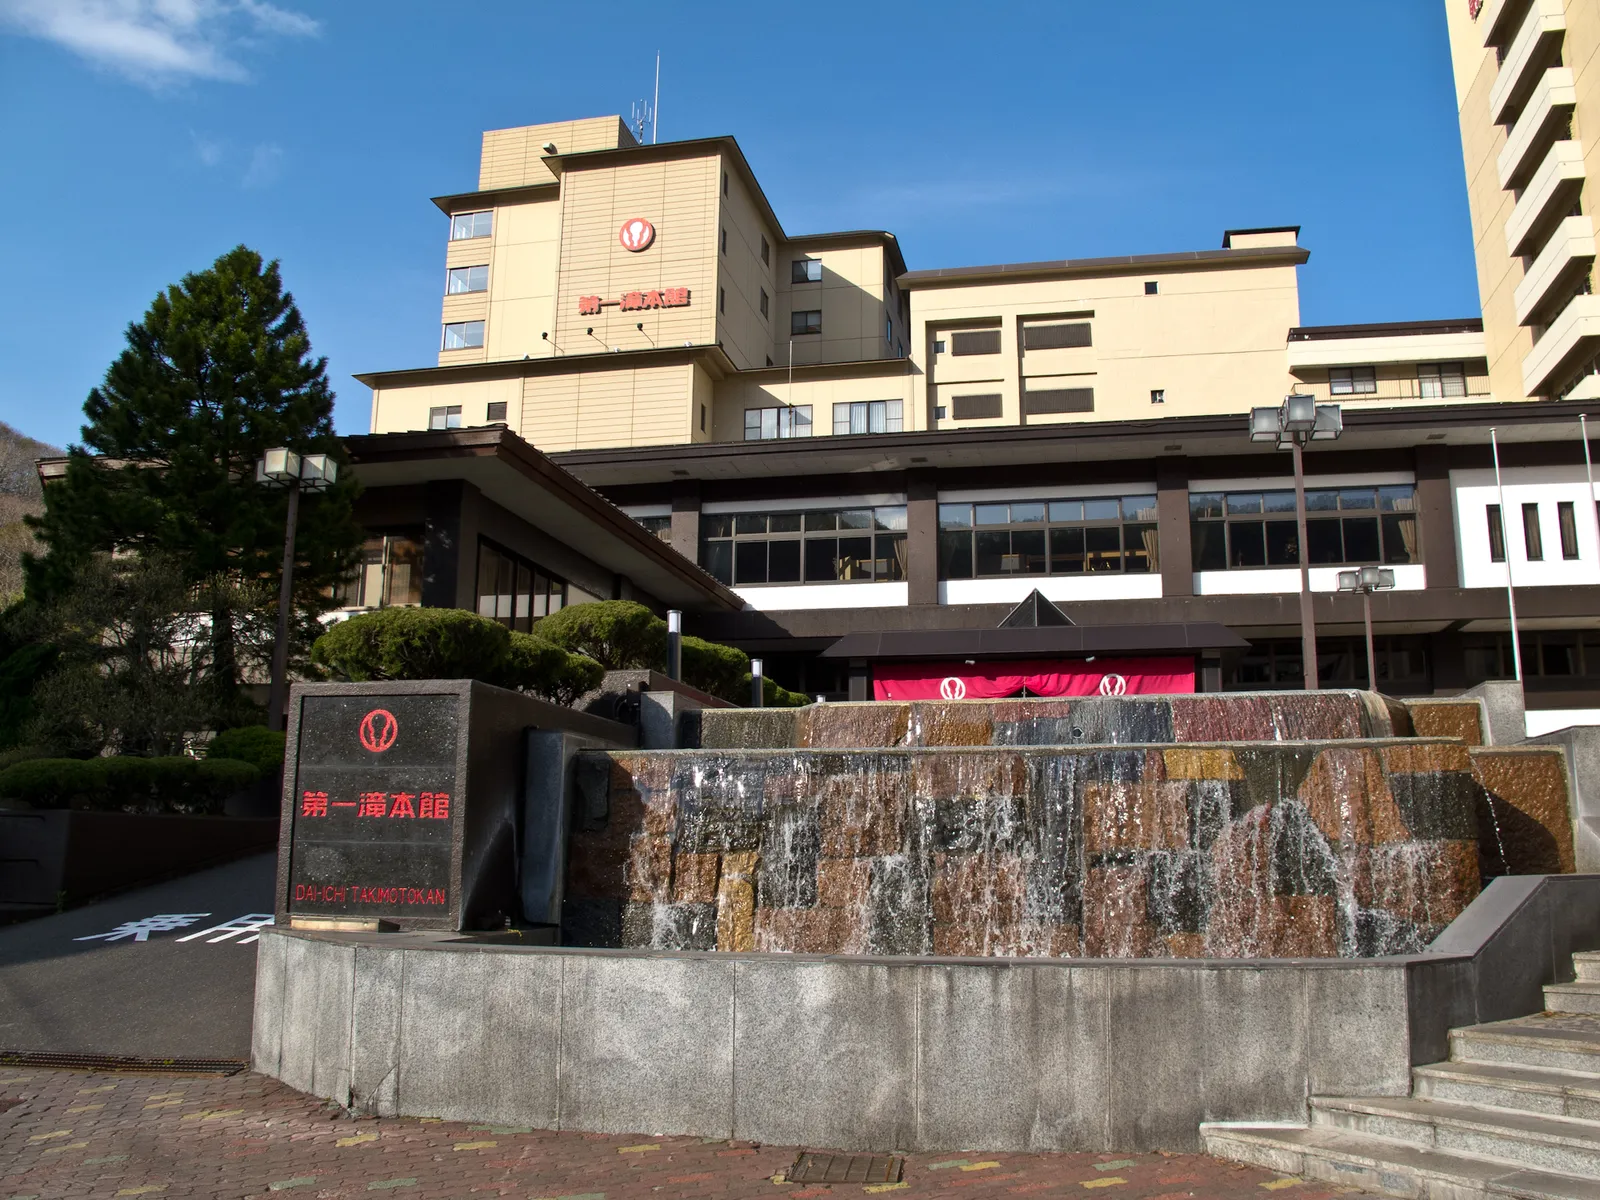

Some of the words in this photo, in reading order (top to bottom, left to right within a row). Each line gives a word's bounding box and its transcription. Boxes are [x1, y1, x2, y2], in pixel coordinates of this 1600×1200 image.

[301, 790, 450, 819] 第一滝本館
[295, 884, 346, 902] DAI-ICHI
[351, 885, 446, 905] TAKIMOTOKAN
